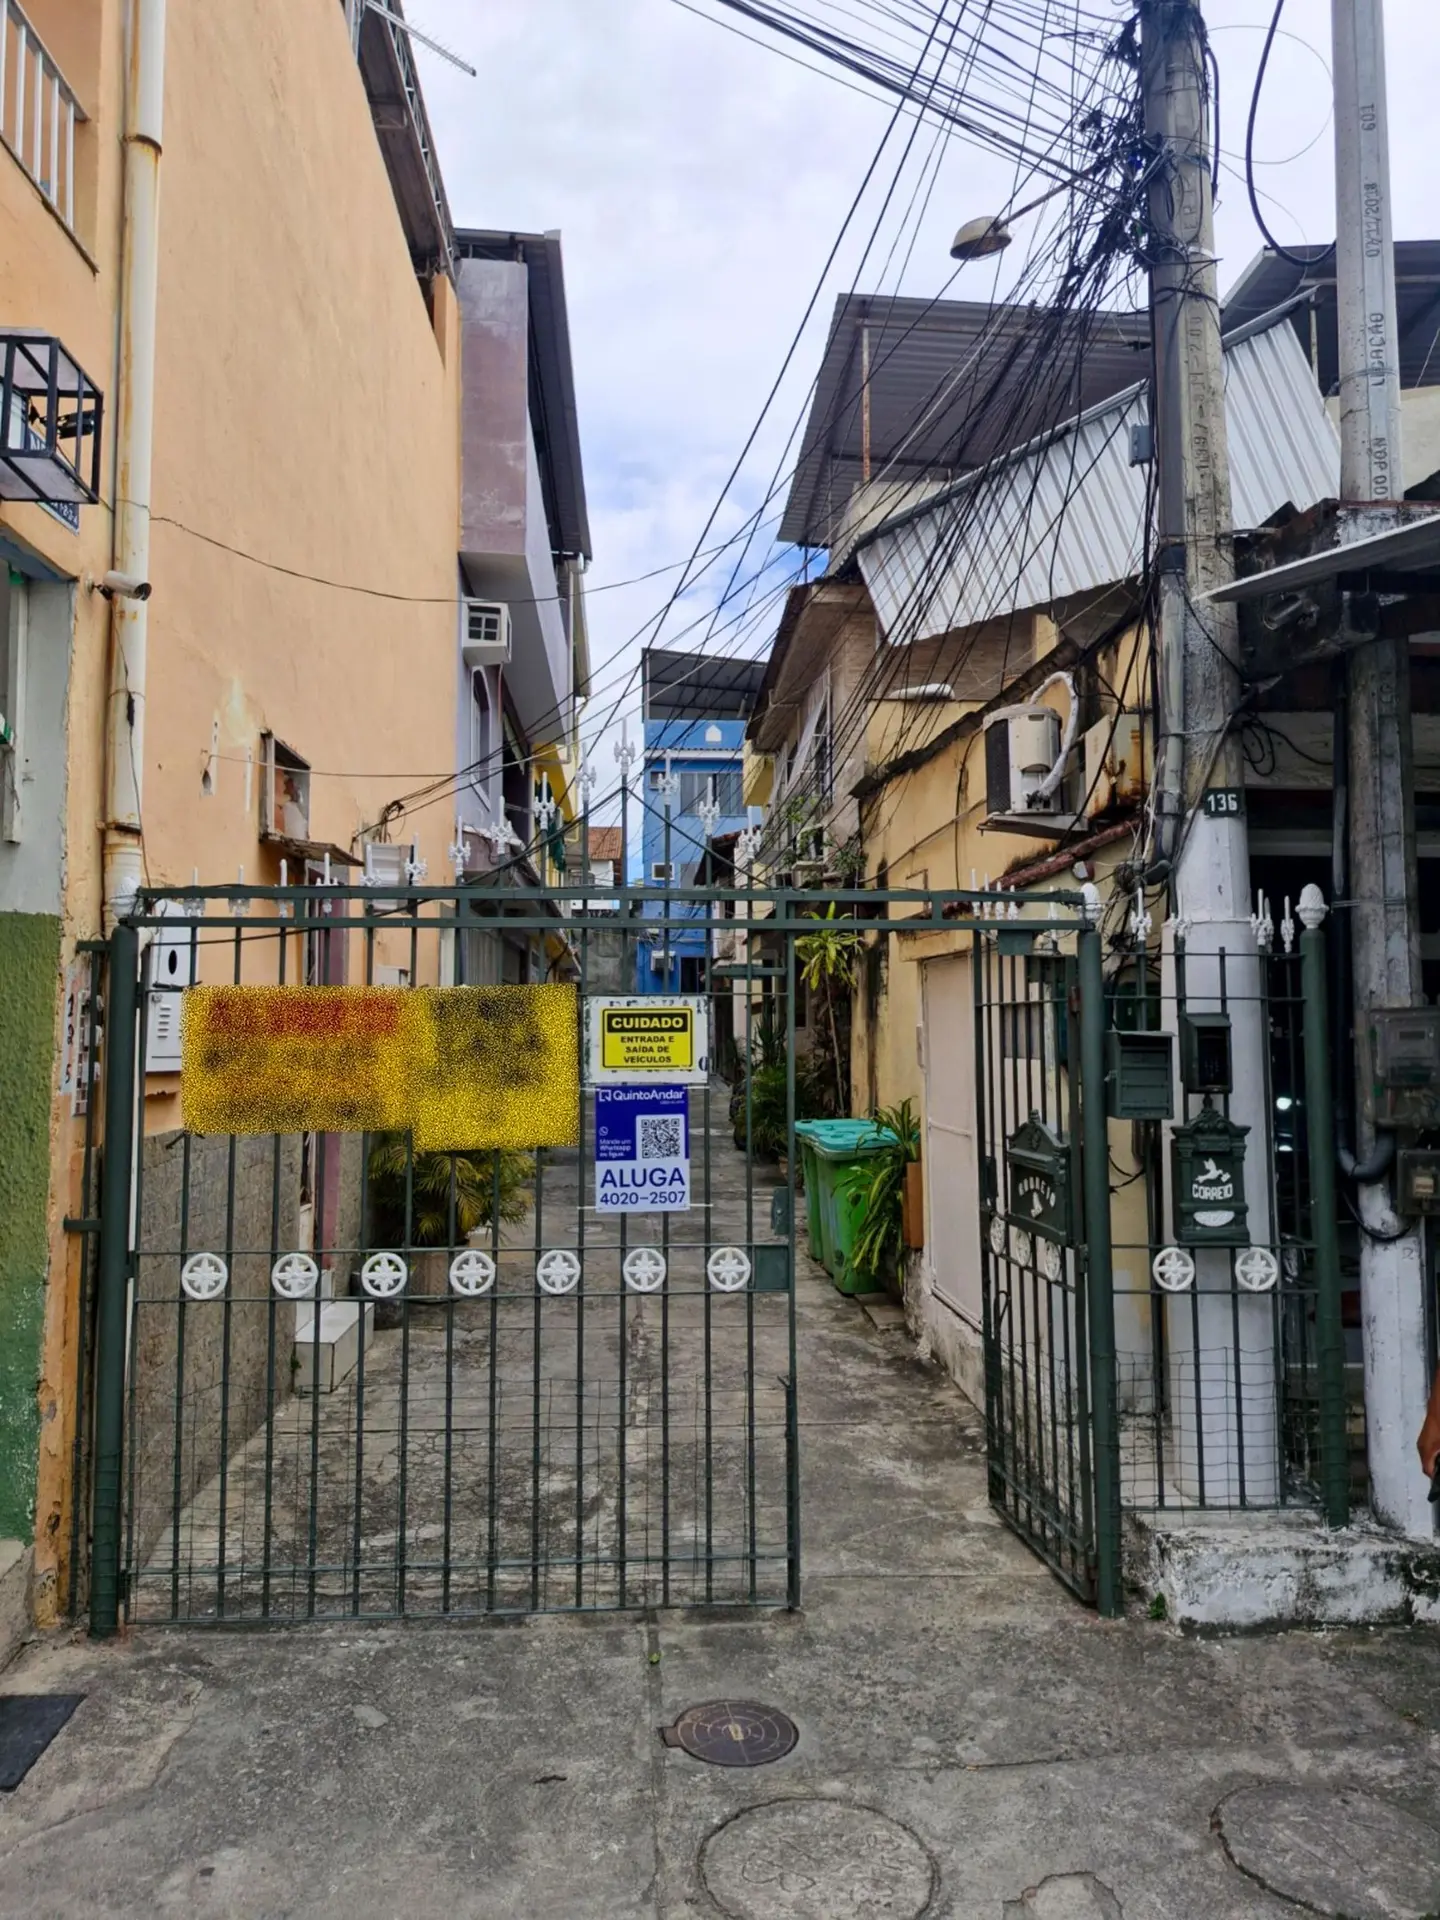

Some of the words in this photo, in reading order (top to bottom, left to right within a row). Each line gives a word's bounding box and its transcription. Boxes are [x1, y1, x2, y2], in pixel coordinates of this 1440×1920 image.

[1360, 103, 1376, 131] 601
[1207, 793, 1238, 812] 136
[611, 1017, 684, 1029] CUIDADO
[625, 1045, 654, 1053] SAÍDA
[624, 1055, 672, 1064] VEÍCULOS
[613, 1089, 685, 1101] QuintoAndar
[600, 1168, 685, 1188] ALUGA
[599, 1190, 686, 1206] 4020-2507
[1192, 1183, 1233, 1200] CORREIO
